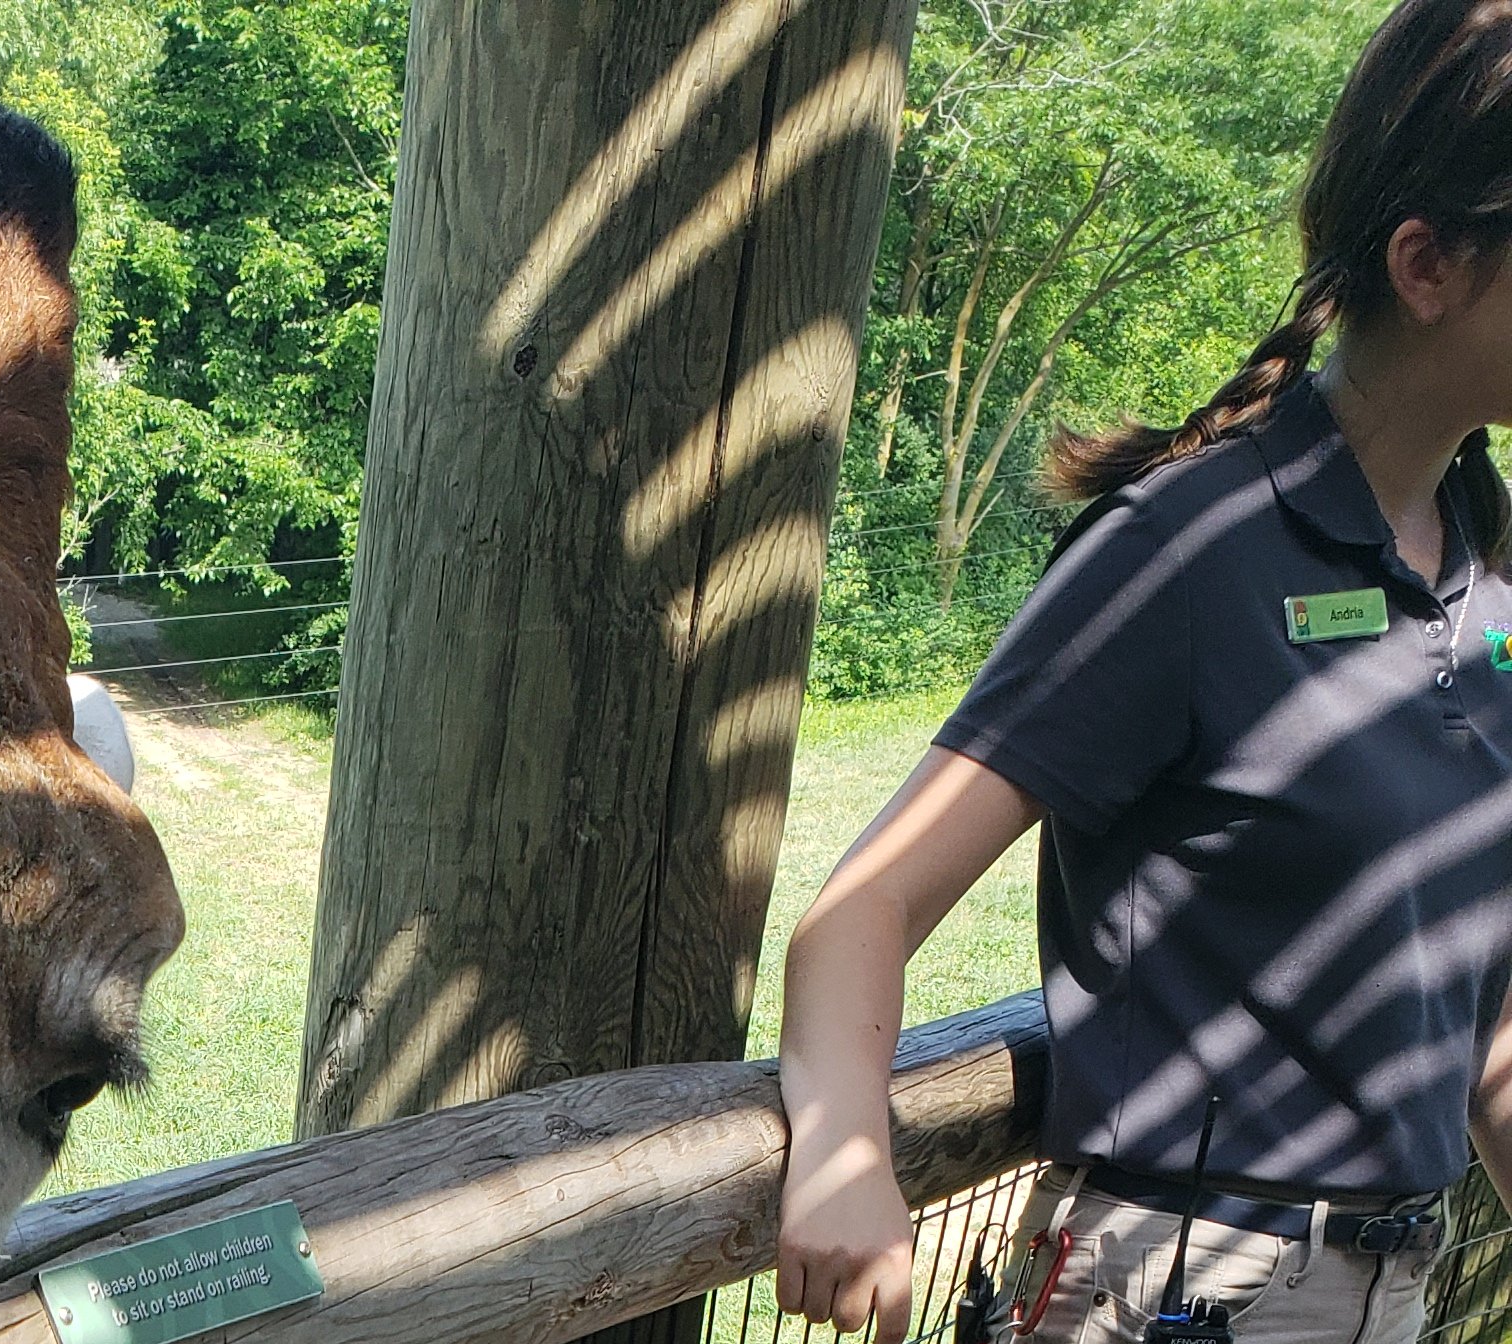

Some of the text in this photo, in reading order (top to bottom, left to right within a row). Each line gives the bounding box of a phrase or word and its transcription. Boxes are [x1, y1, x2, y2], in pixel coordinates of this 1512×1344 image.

[1330, 606, 1364, 622] Andria
[88, 1234, 273, 1303] Please do not allow children
[112, 1263, 271, 1327] to sit or stand on railing.
